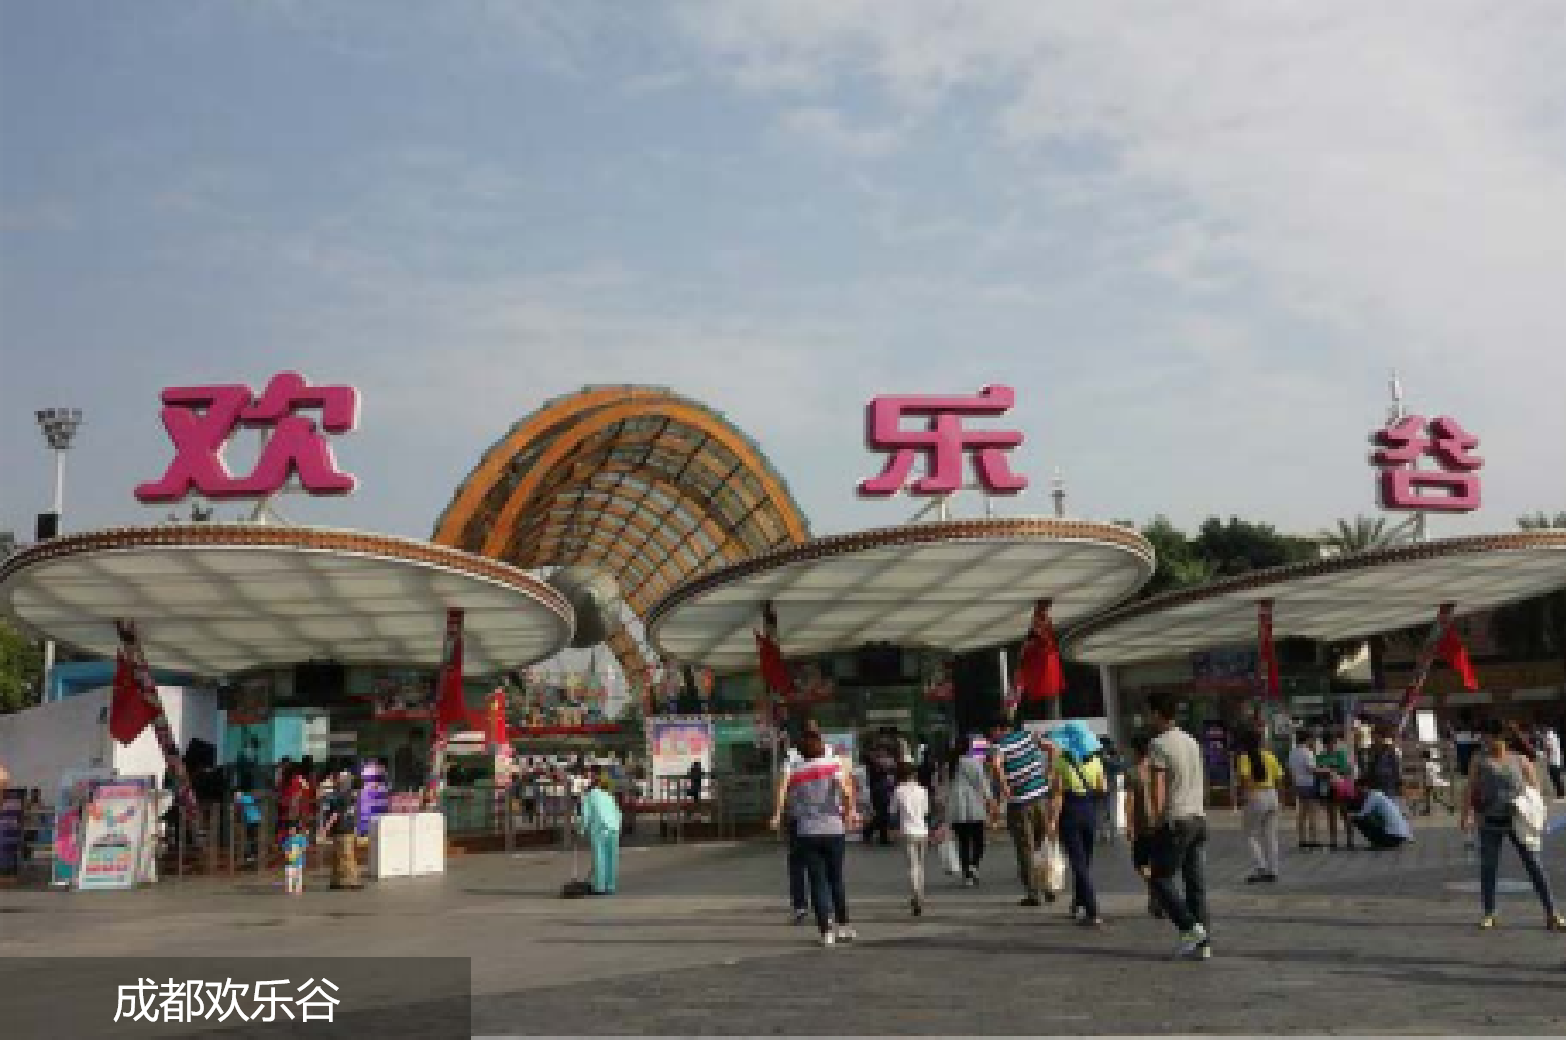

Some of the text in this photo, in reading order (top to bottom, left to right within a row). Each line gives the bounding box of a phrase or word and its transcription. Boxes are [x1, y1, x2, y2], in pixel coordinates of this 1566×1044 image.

[135, 371, 1483, 512] 欢 乐 谷
